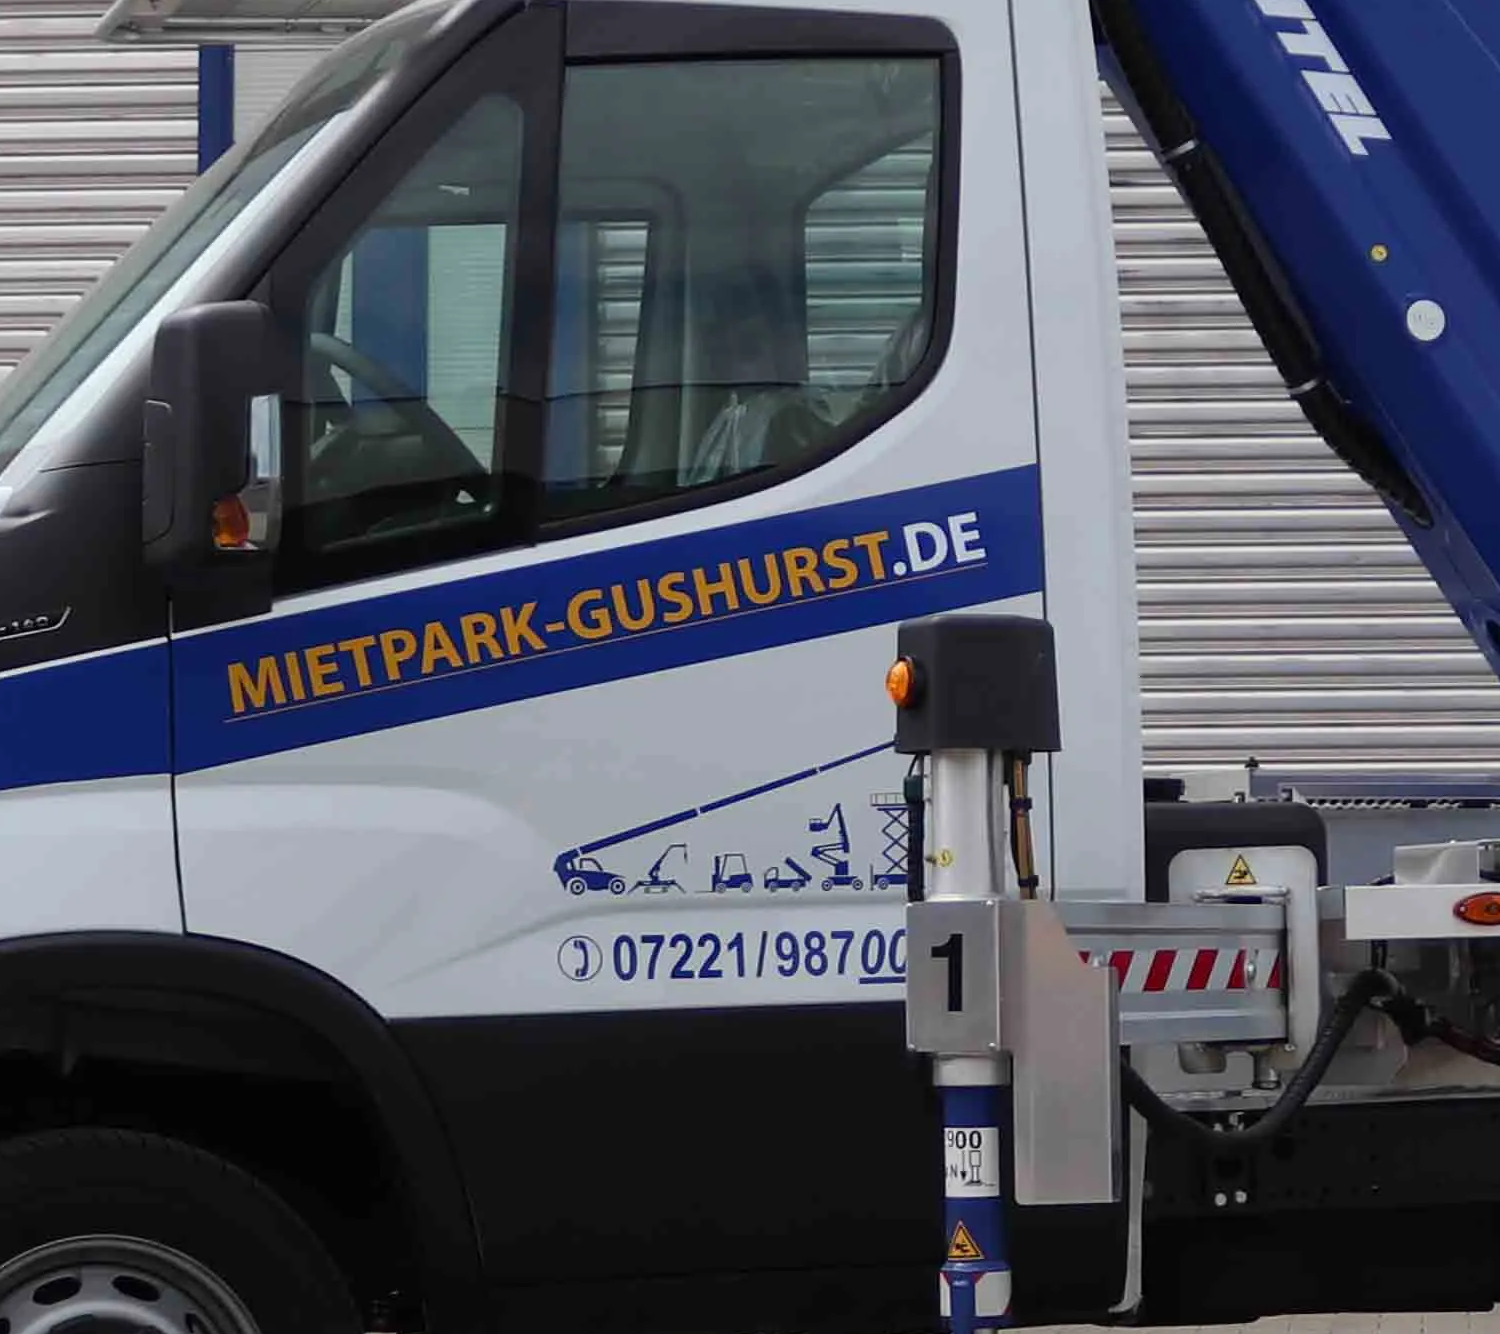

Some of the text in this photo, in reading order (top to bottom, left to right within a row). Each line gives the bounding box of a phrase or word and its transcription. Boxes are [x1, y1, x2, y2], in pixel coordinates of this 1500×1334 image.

[227, 511, 988, 716] MIETPARK-GUSHURST.DE
[611, 928, 908, 981] 07221/98700
[930, 933, 964, 1012] 1
[946, 1130, 982, 1149] 900
